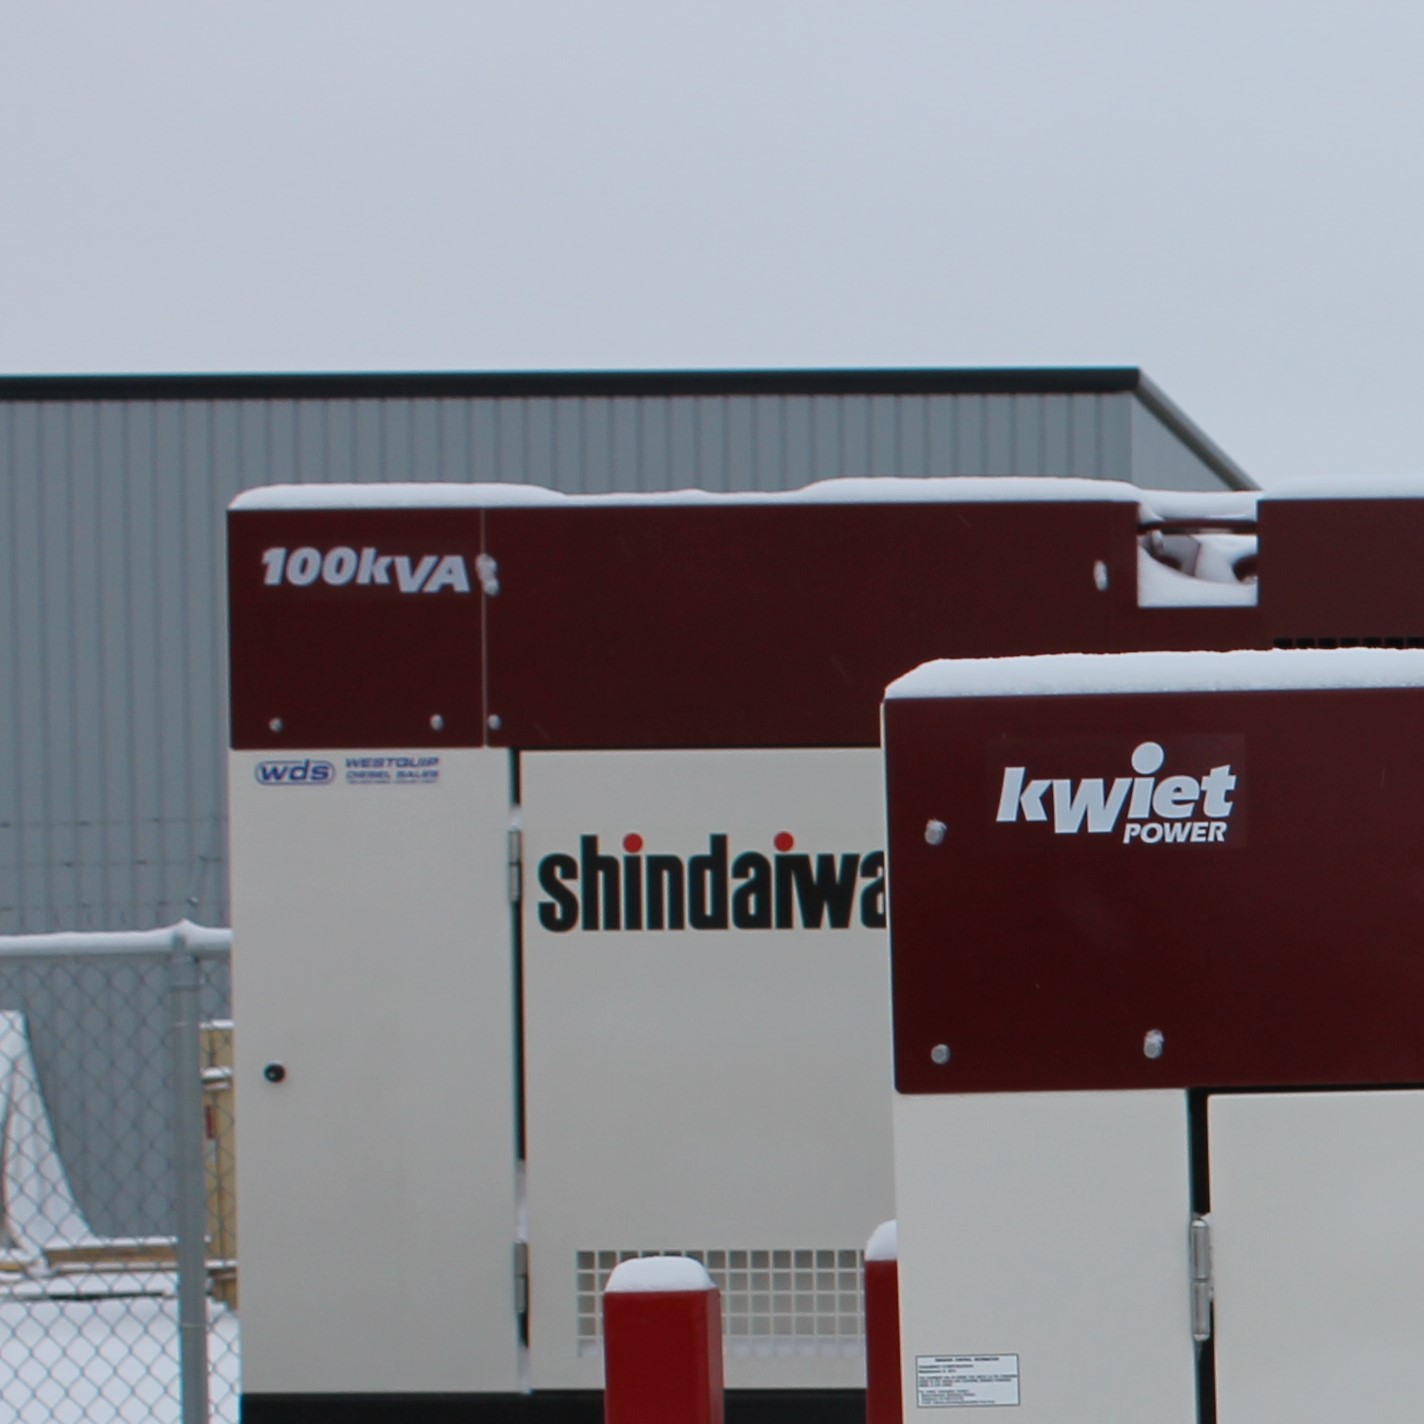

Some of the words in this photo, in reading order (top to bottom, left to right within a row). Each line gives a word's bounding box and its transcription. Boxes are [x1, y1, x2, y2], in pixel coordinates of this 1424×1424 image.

[261, 546, 471, 593] 100kVA
[260, 758, 330, 781] wds
[995, 741, 1237, 834] kwiet
[1123, 821, 1228, 844] POWER
[537, 831, 887, 932] shindaiwa
